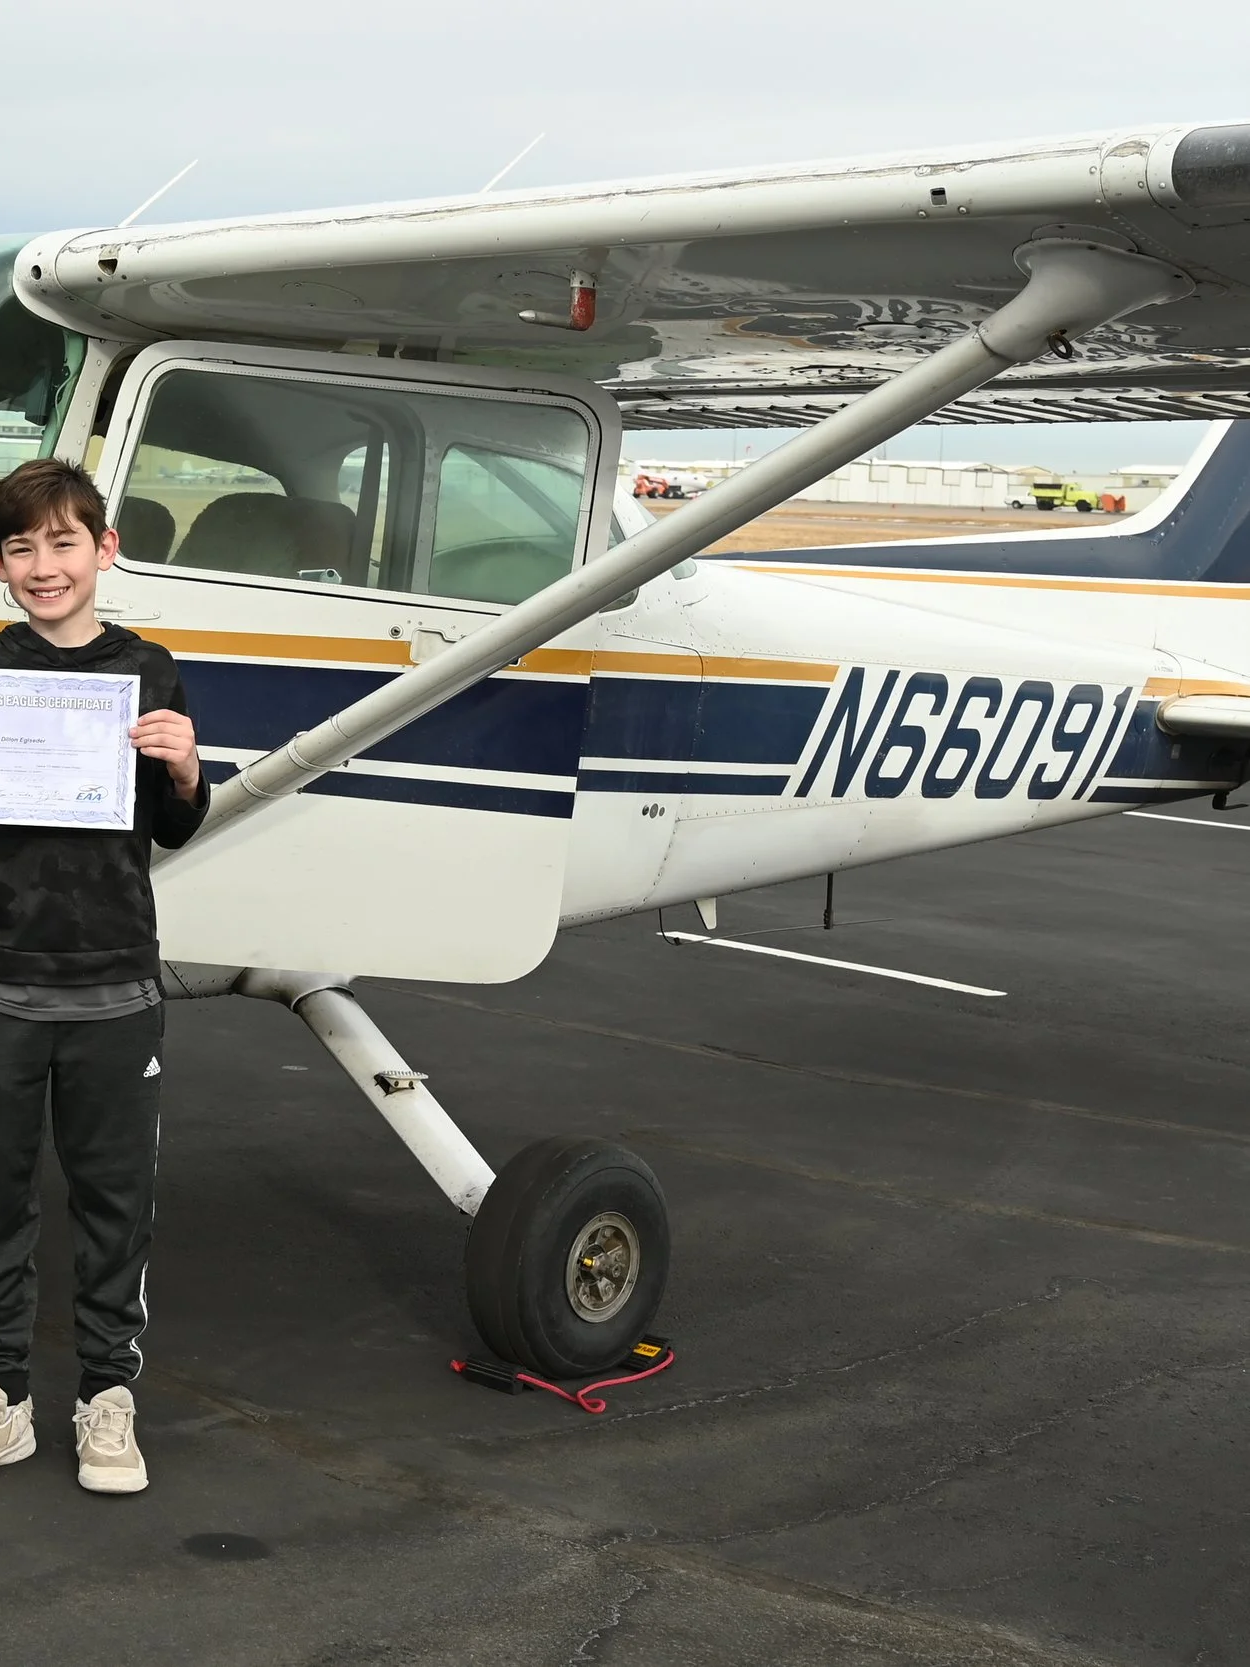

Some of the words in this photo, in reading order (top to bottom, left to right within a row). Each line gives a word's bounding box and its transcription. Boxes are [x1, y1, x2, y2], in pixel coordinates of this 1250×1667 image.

[6, 694, 46, 709] EAGLES
[48, 696, 113, 711] CERTIFICATE
[794, 666, 1134, 801] N66091
[75, 792, 102, 801] EAA
